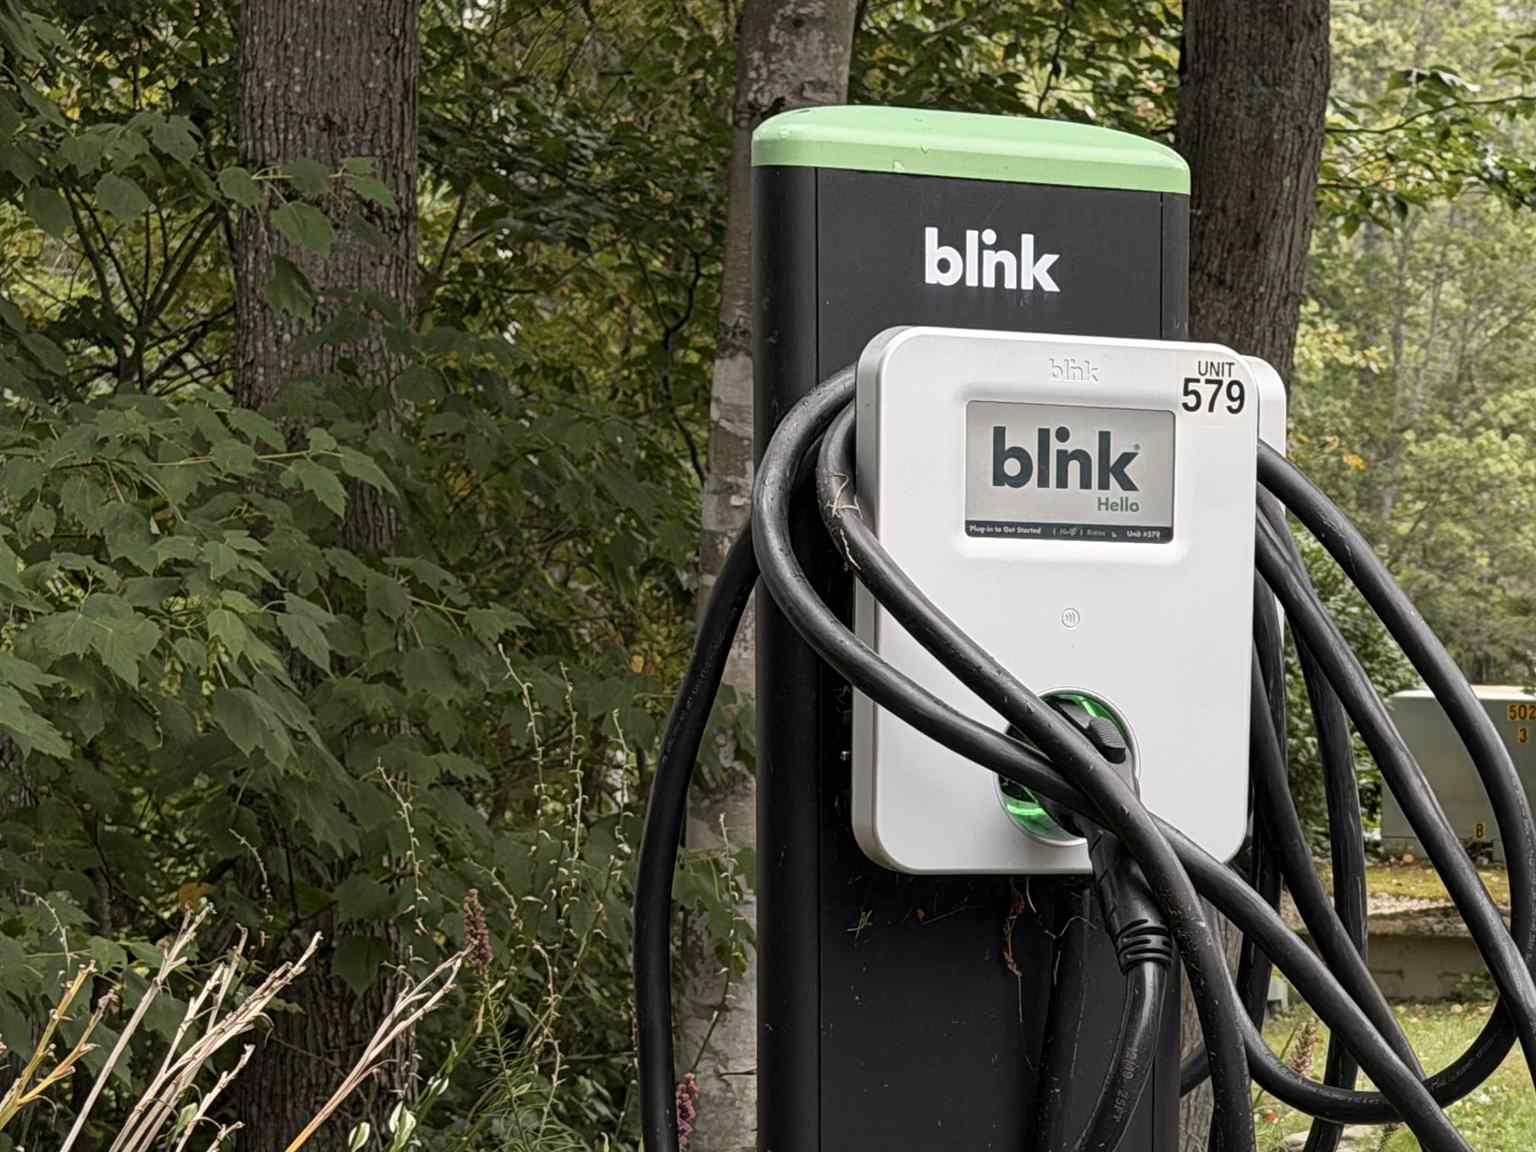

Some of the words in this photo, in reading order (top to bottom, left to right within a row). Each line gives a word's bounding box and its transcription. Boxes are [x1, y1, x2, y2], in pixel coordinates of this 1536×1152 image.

[925, 227, 1061, 292] blink
[1048, 357, 1099, 384] blink
[1198, 360, 1235, 378] UNIT
[1182, 377, 1245, 414] 579
[992, 426, 1140, 492] blink
[1097, 496, 1140, 513] Hello
[1519, 728, 1529, 744] 3
